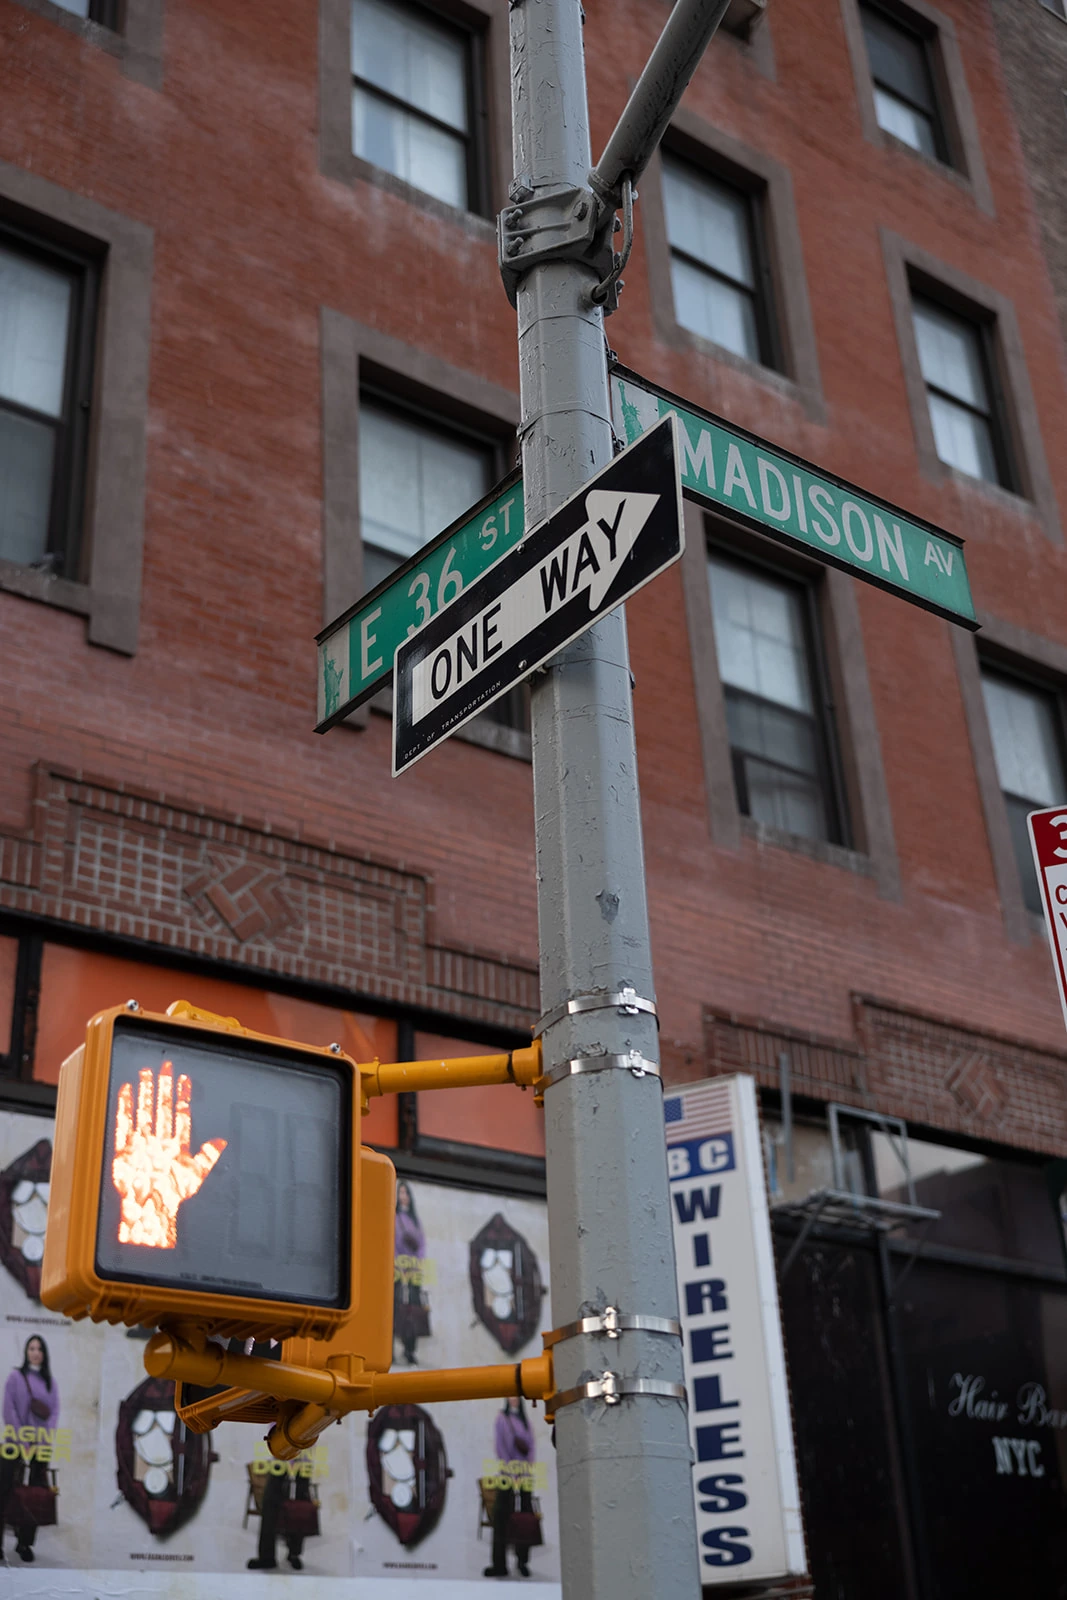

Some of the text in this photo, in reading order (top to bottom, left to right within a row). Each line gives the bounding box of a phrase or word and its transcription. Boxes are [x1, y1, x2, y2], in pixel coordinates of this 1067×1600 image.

[676, 417, 954, 582] MADISON AV
[360, 498, 515, 681] E 36 ST
[430, 498, 628, 700] ONE WAY
[404, 680, 502, 760] DEPT OF TRANSPORTATION
[673, 1184, 754, 1567] WIRELESS
[948, 1372, 1009, 1419] Hair
[0, 1424, 72, 1445] AGNE
[0, 1442, 72, 1462] OVER
[992, 1436, 1045, 1478] NYC
